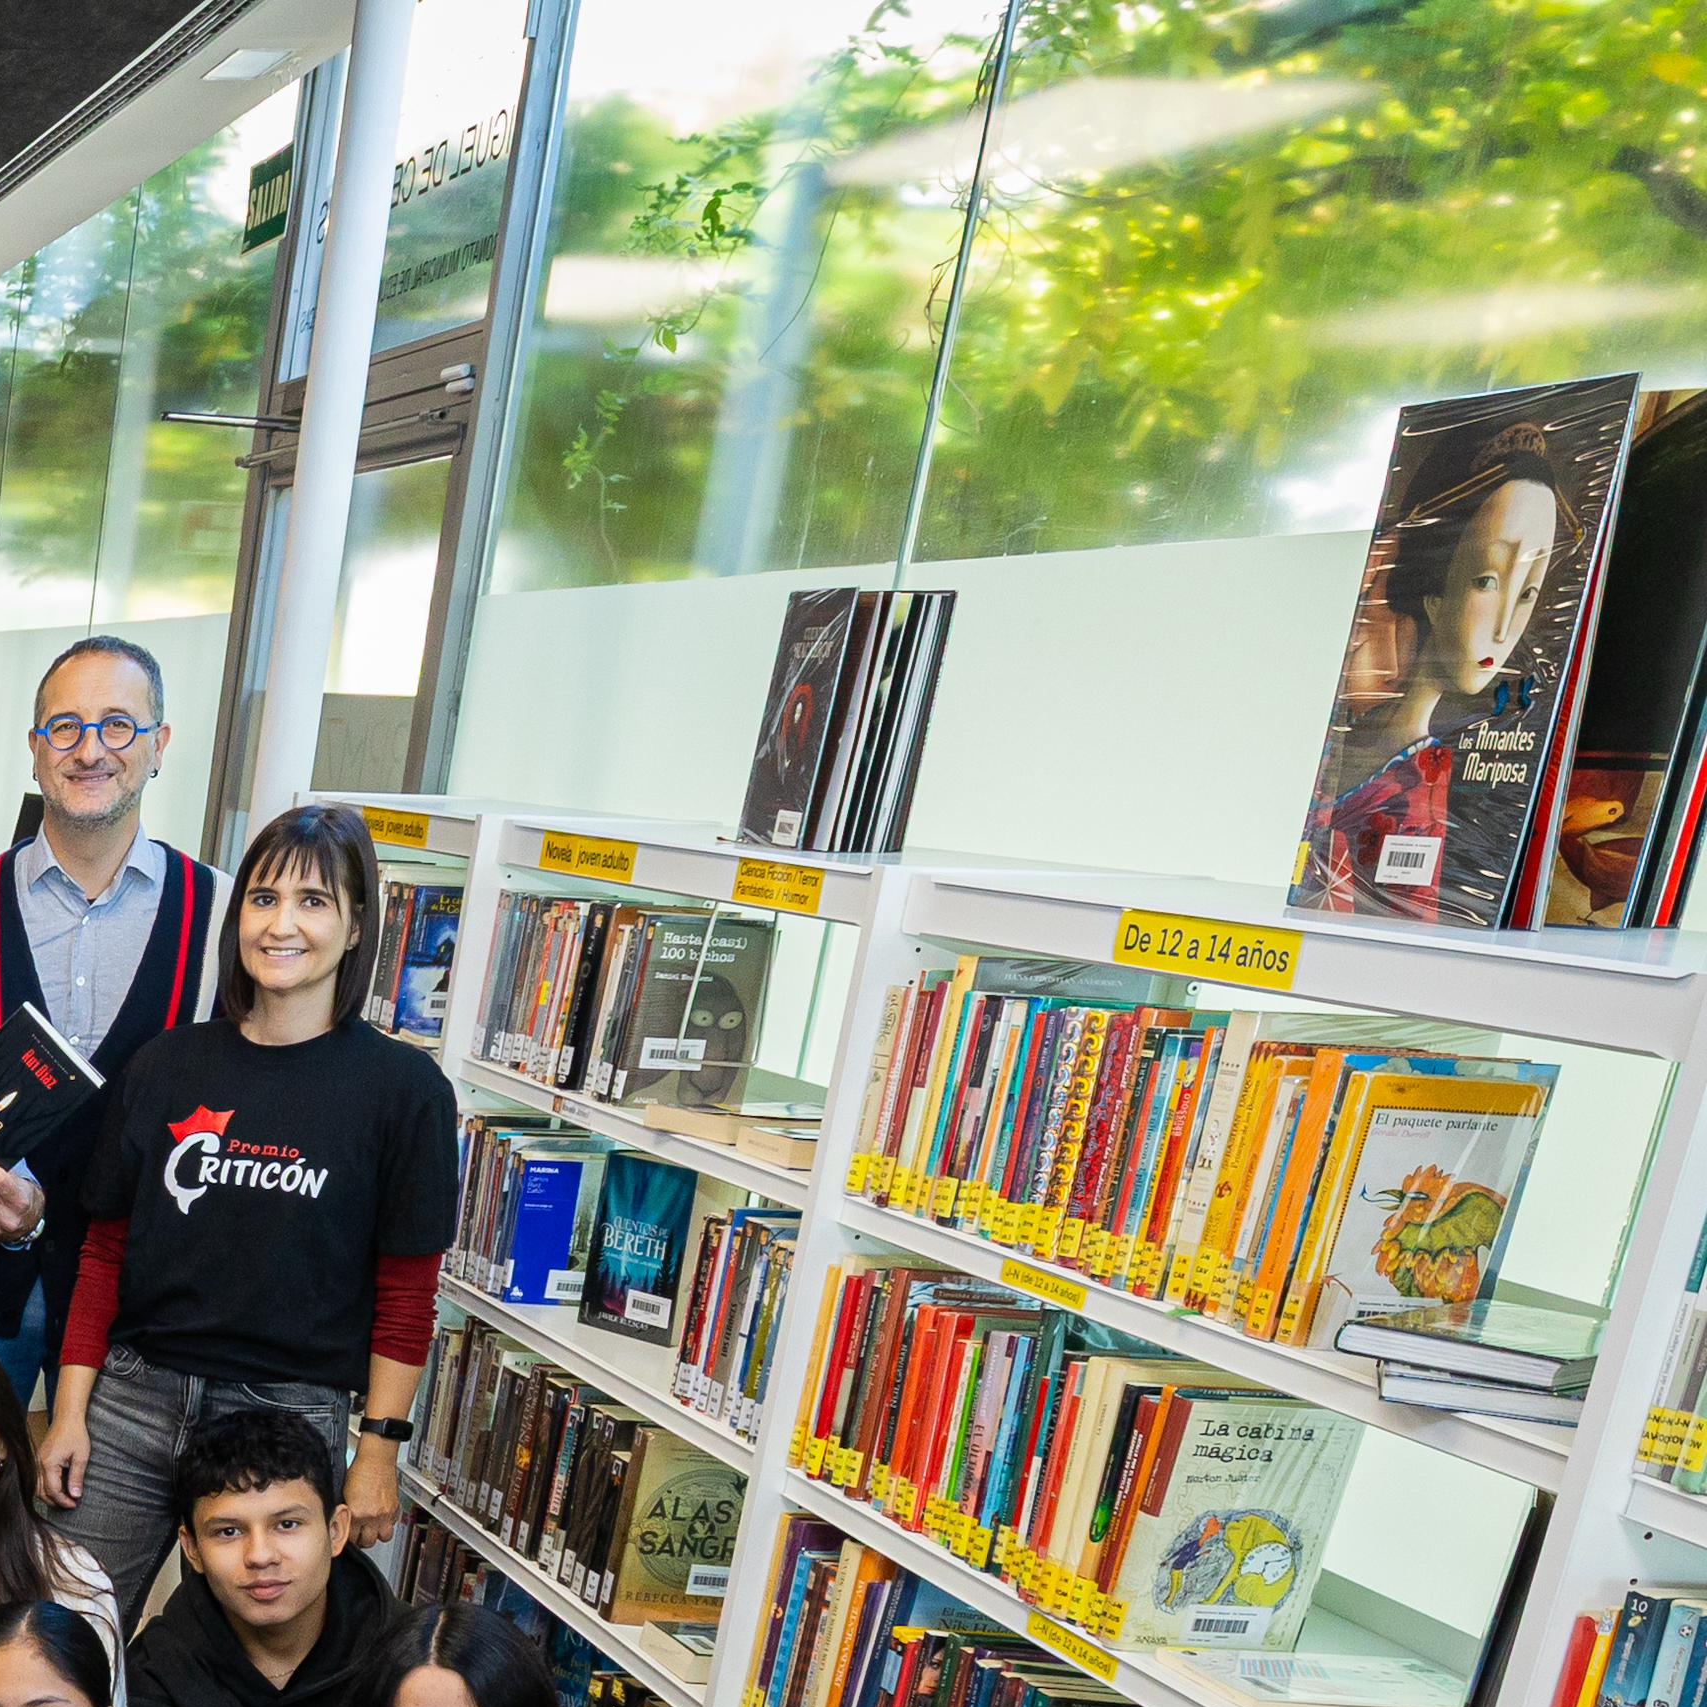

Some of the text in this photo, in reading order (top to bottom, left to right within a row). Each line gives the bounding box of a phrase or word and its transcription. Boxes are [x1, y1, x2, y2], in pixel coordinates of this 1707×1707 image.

[1458, 721, 1536, 756] Los Amantes
[1463, 751, 1529, 788] Mariposa
[545, 841, 630, 872] Novela joven adulto
[740, 860, 766, 879] Ciencia
[780, 884, 810, 905] Humor
[663, 931, 748, 952] Hasta (casi)
[1125, 923, 1291, 972] De 12 a 14 años
[660, 946, 687, 961] 100
[1375, 1112, 1390, 1128] El
[1391, 1115, 1443, 1134] paquete
[227, 1138, 300, 1159] Premio
[164, 1131, 329, 1216] CRITICÓN
[529, 1165, 559, 1175] MARINA
[613, 1214, 657, 1239] CUENTOS
[603, 1221, 667, 1259] BERETH
[1199, 1419, 1315, 1443] La cabina
[1193, 1442, 1274, 1463] mágica
[648, 1499, 735, 1521] ALAS
[1630, 1598, 1649, 1613] 10
[1033, 1620, 1113, 1675] J-N (de 12 14 años)
